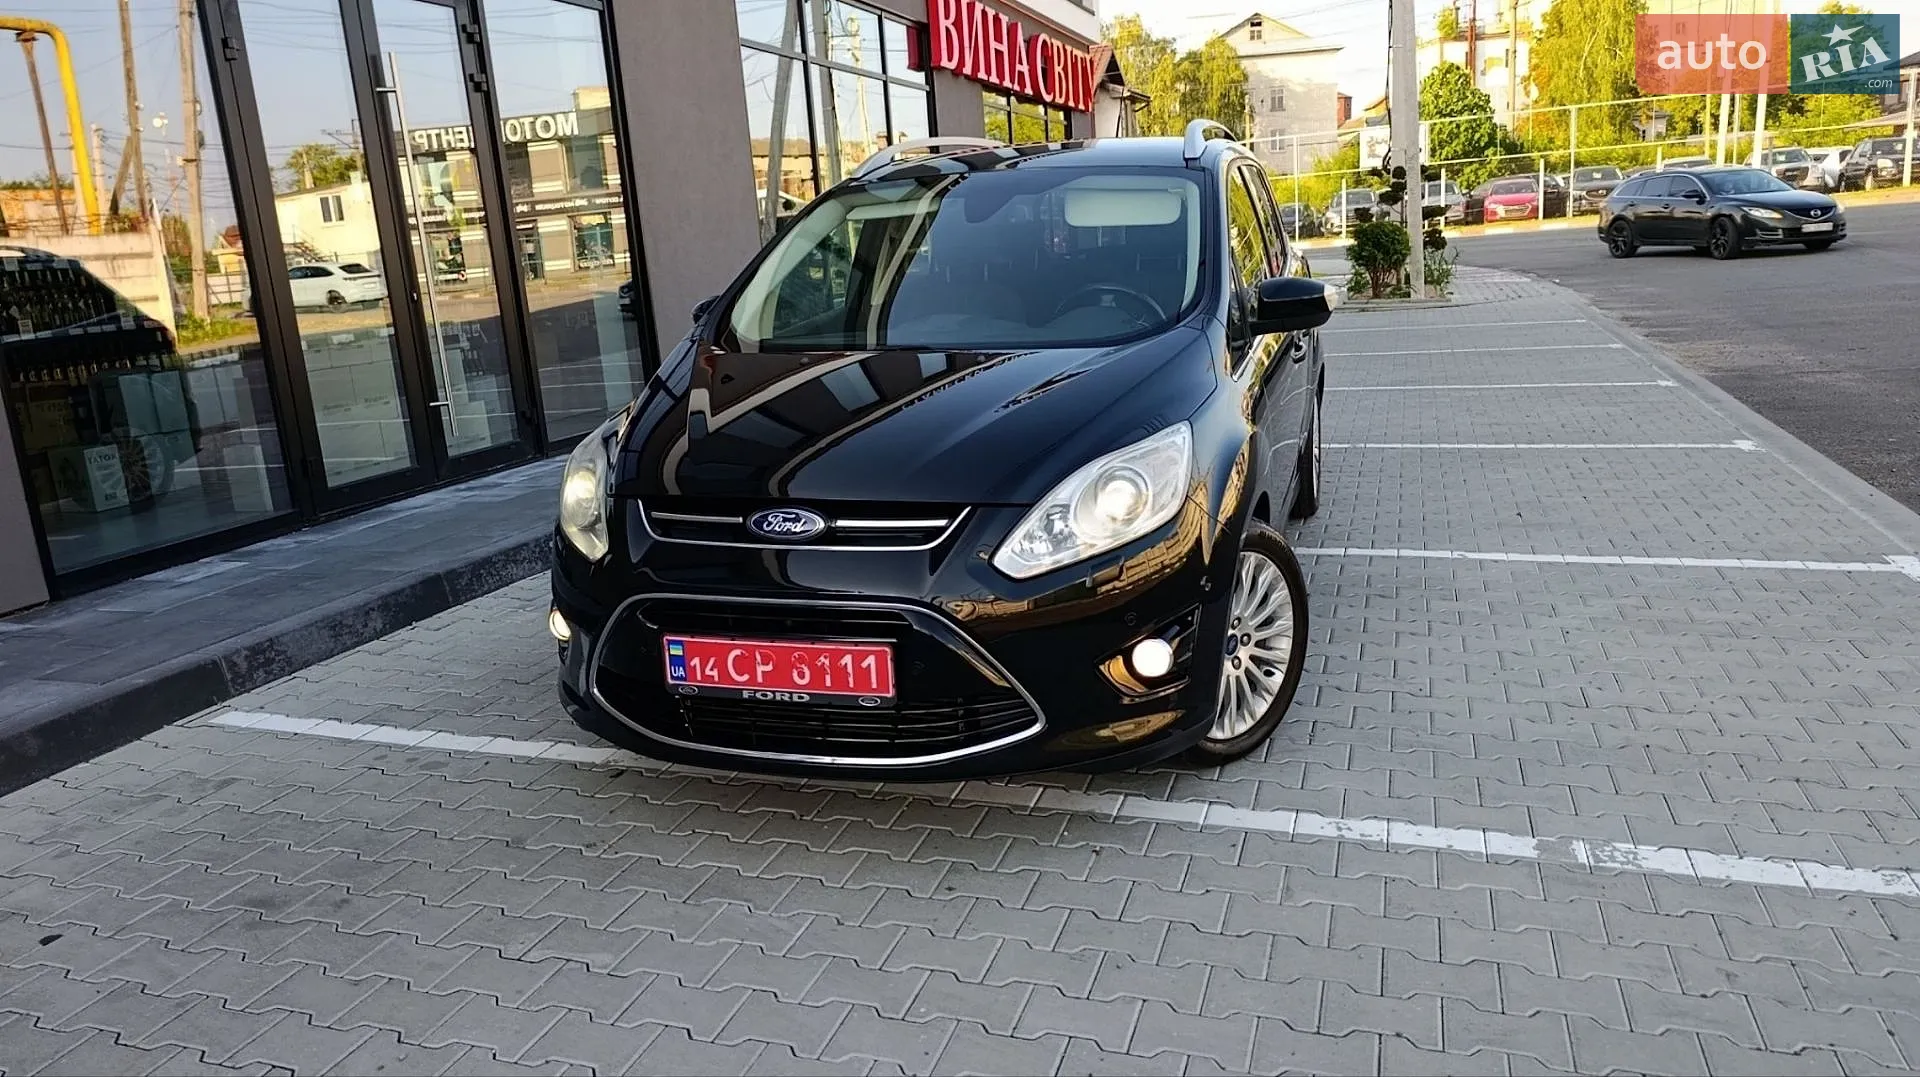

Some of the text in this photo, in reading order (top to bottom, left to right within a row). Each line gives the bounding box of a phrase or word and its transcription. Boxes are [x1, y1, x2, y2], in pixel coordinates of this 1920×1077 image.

[937, 0, 1034, 96] ВИНА
[762, 512, 808, 533] Ford
[671, 665, 686, 678] UA
[689, 656, 719, 682] 14
[742, 690, 810, 703] FORD
